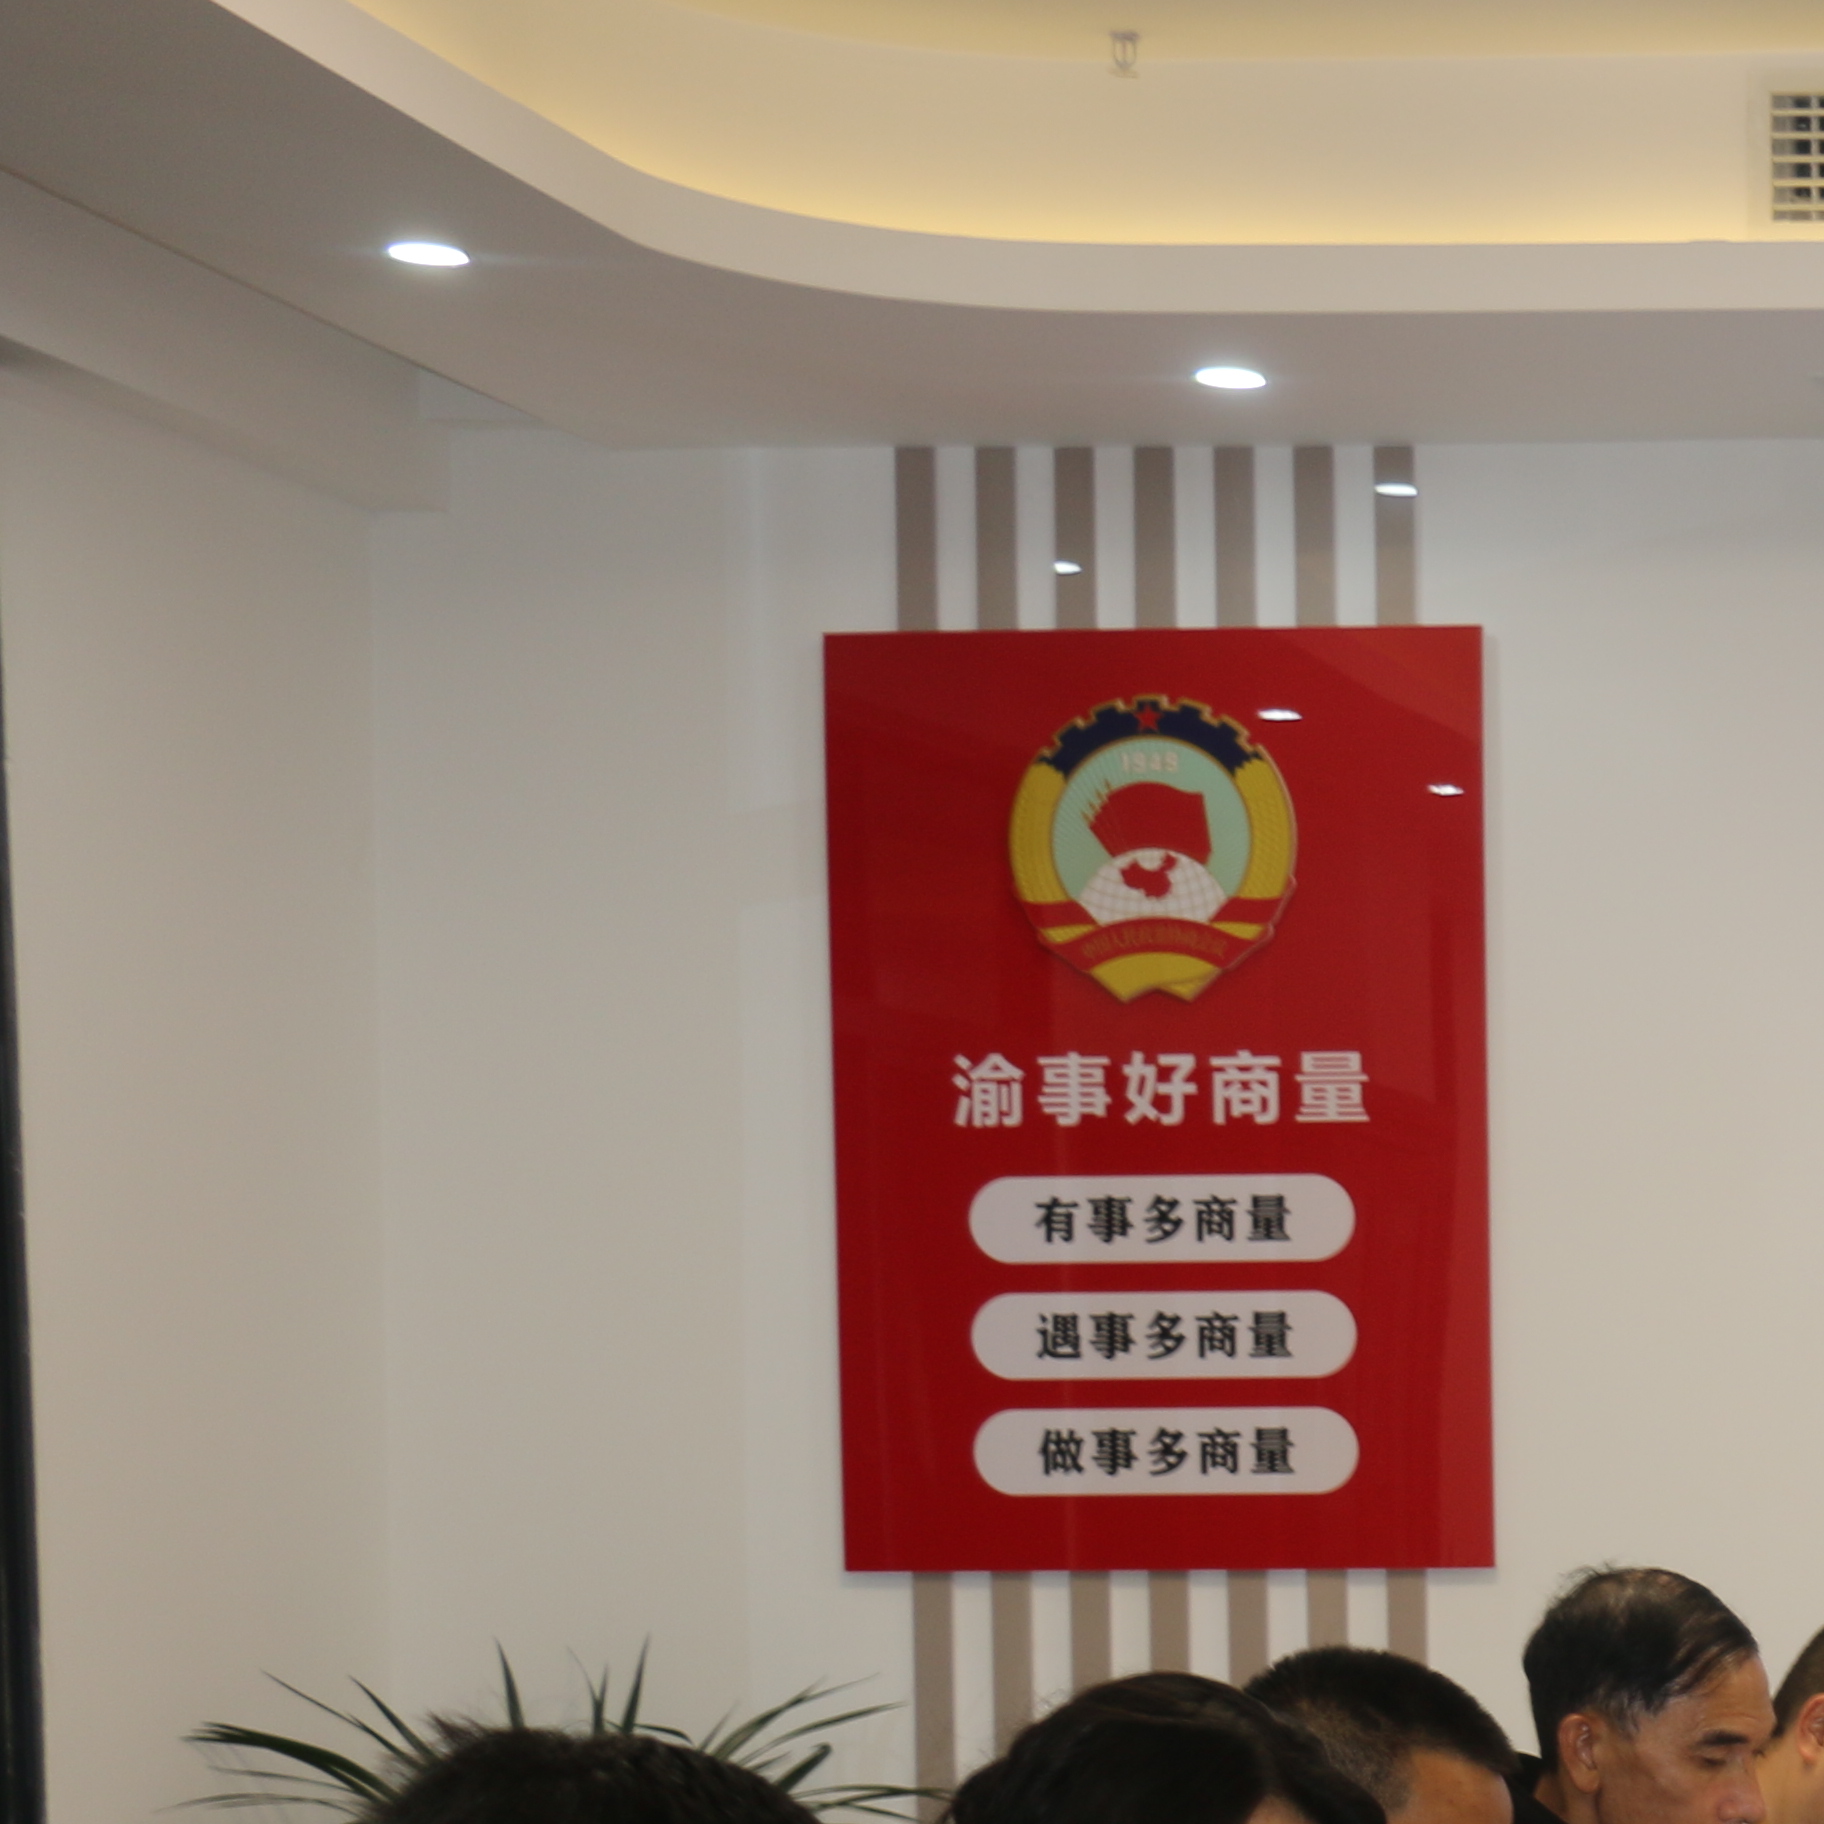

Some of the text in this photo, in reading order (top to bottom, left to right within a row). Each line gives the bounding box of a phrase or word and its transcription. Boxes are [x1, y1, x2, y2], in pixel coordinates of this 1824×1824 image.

[951, 1049, 1371, 1129] 渝事好商量
[1035, 1194, 1291, 1245] 有事多商量
[1036, 1311, 1293, 1361] 遇事多商量
[1038, 1427, 1295, 1477] 做事多商量
